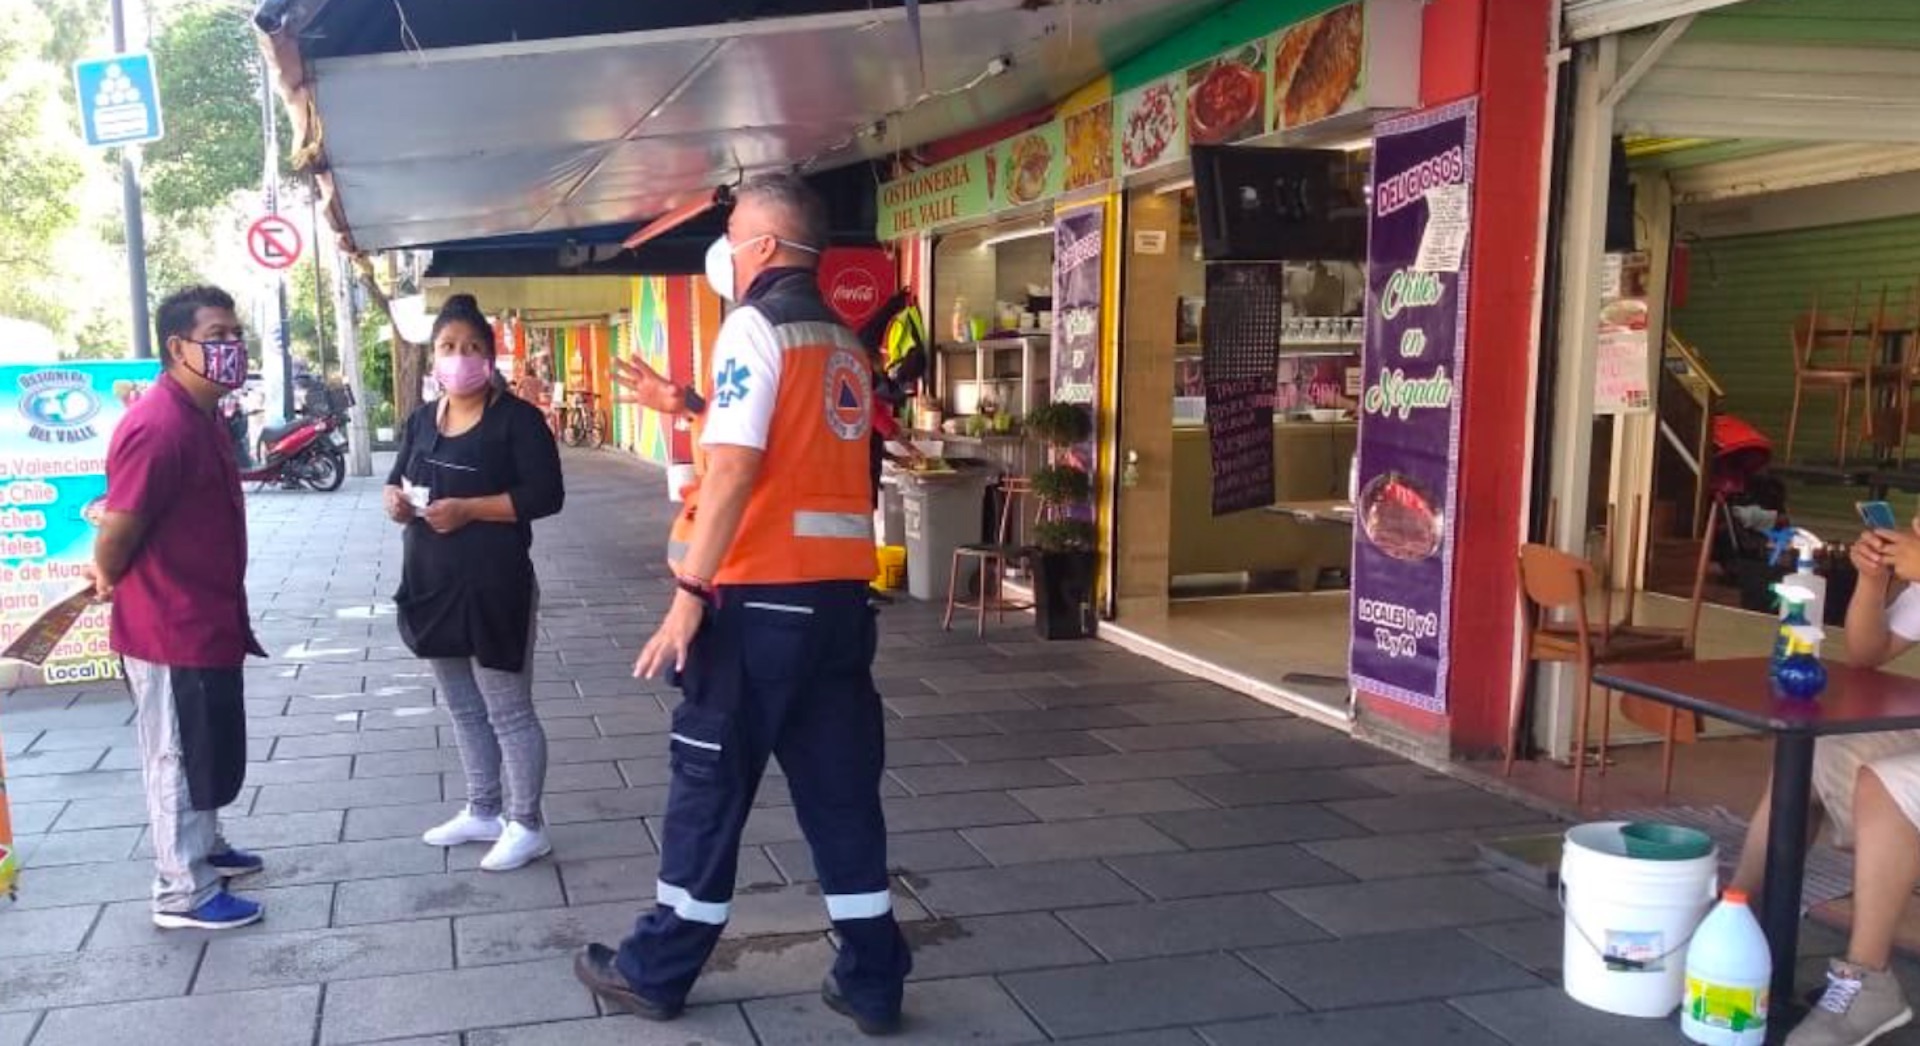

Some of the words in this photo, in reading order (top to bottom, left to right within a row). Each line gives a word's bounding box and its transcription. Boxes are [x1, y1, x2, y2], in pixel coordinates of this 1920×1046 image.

[884, 163, 970, 208] OSTIONERIA
[1378, 147, 1462, 216] DELICIOSOS
[893, 207, 916, 232] DEL
[919, 195, 959, 227] VALLE
[1382, 268, 1444, 319] Chiles
[1401, 329, 1426, 357] en
[1365, 365, 1452, 419] Nogada
[28, 424, 51, 442] DEL
[56, 425, 98, 443] VALLE
[10, 484, 54, 500] Chile
[20, 564, 41, 580] de
[48, 561, 82, 578] Hua
[1359, 598, 1405, 630] LOCALES
[48, 662, 96, 680] Local
